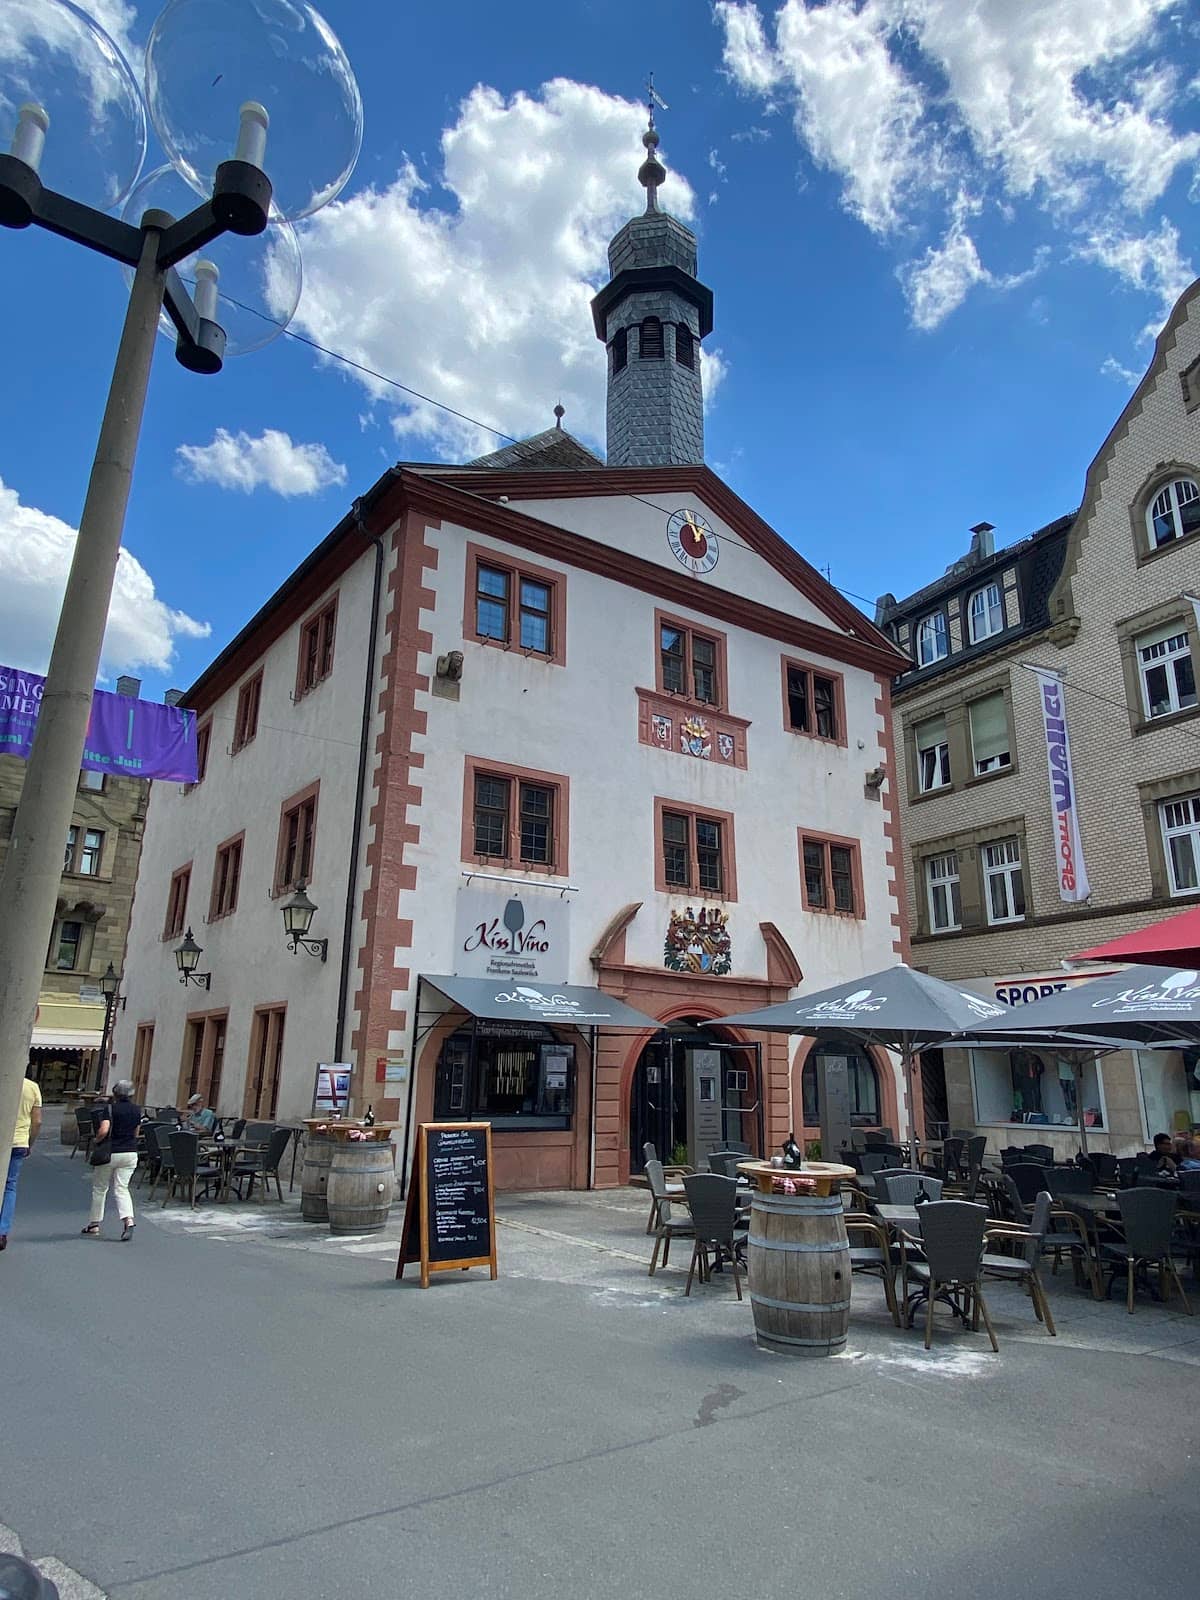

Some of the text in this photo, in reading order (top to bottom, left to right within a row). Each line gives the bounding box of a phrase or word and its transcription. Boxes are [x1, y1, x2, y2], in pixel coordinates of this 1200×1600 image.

[0, 674, 45, 700] SING
[83, 748, 110, 764] itte
[113, 755, 142, 769] Juli
[464, 918, 549, 953] Kiss Vino
